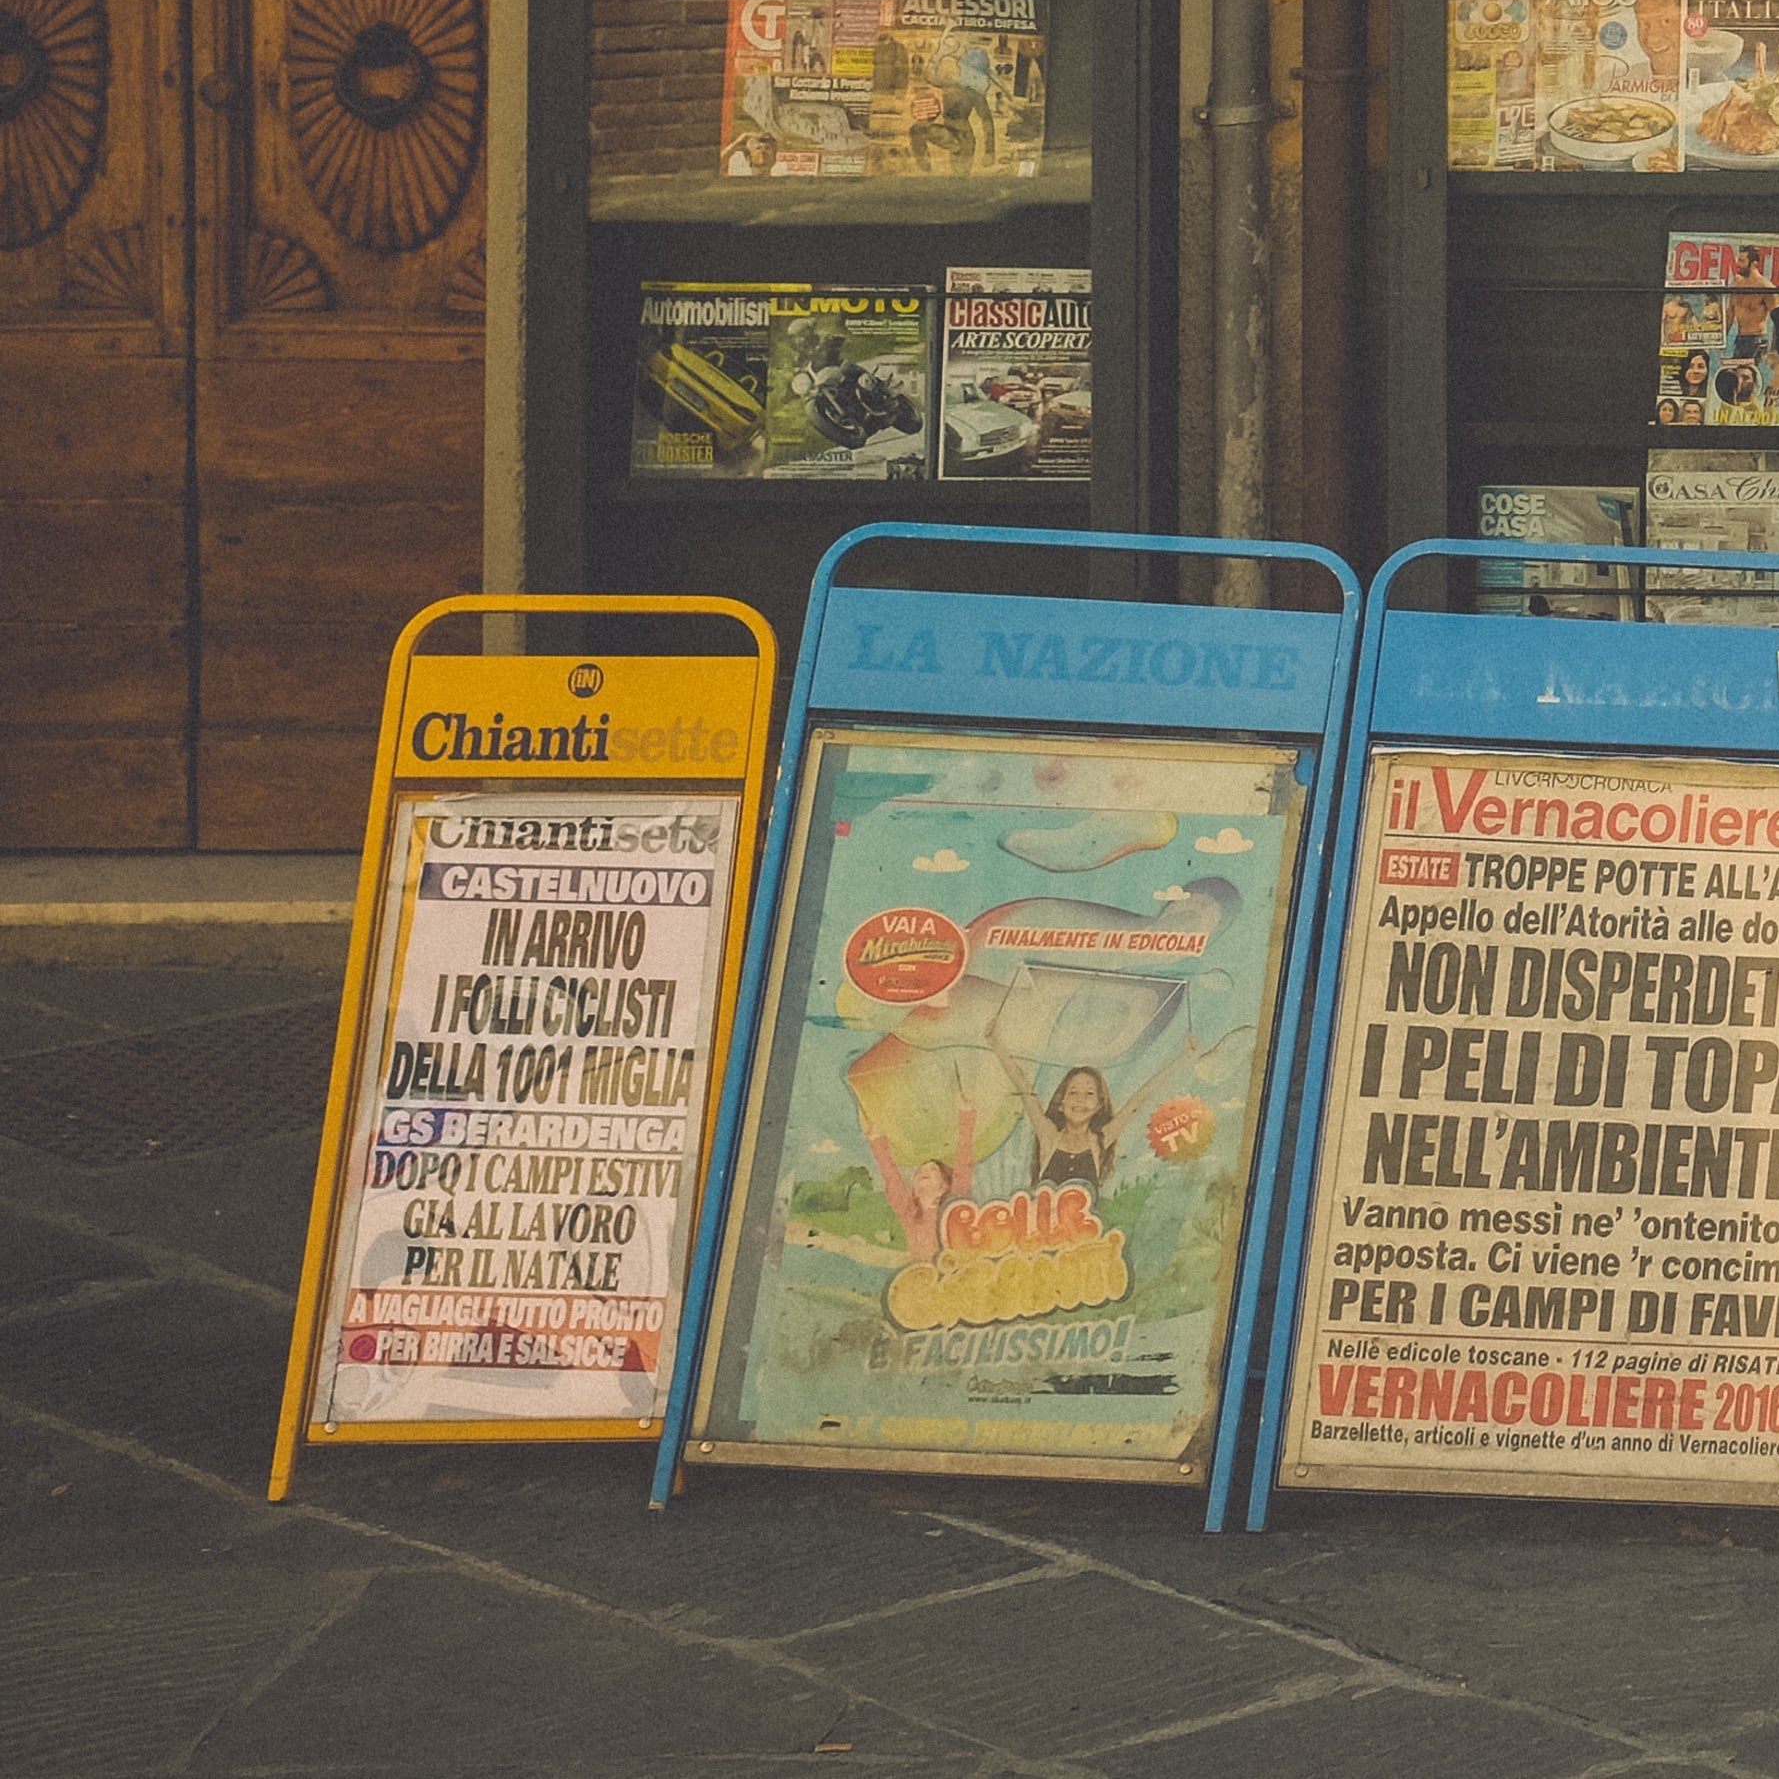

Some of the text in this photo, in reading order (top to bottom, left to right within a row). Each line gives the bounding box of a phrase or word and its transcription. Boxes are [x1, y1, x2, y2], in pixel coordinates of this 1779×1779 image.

[951, 333, 1000, 349] ARTE
[1480, 493, 1546, 515] COSE
[1647, 473, 1727, 502] CASA
[1480, 517, 1545, 539] CASA
[977, 630, 1299, 693] NAZIONE
[441, 865, 708, 905] CASTELNUOVO
[1387, 852, 1696, 898] ESTATE TROPPE POTTE
[1379, 896, 1493, 938] Appello
[522, 909, 646, 971] ARRIVO
[988, 928, 1206, 954] FINALMENTE EDICOLA!
[1384, 941, 1499, 1019] NON
[543, 975, 677, 1038] CICLISTI
[1399, 1025, 1542, 1104] PELI
[1553, 1031, 1631, 1109] DI
[441, 1111, 686, 1151] BERARDENGA
[508, 1201, 637, 1245] LAVORO
[502, 1249, 623, 1293] NATALE
[1532, 1244, 1621, 1278] viene
[496, 1298, 567, 1329] TUTTO
[1328, 1278, 1418, 1324] PER
[1458, 1283, 1616, 1333] CAMPI
[1386, 1340, 1462, 1364] edicole
[1468, 1343, 1550, 1368] toscane
[1570, 1350, 1609, 1368] 112
[1612, 1351, 1683, 1375] pagine
[1318, 1364, 1706, 1431] VERNACOLIERE
[1310, 1419, 1410, 1448] Barzellette,
[1413, 1423, 1476, 1449] articoli
[1495, 1427, 1565, 1451] vignette
